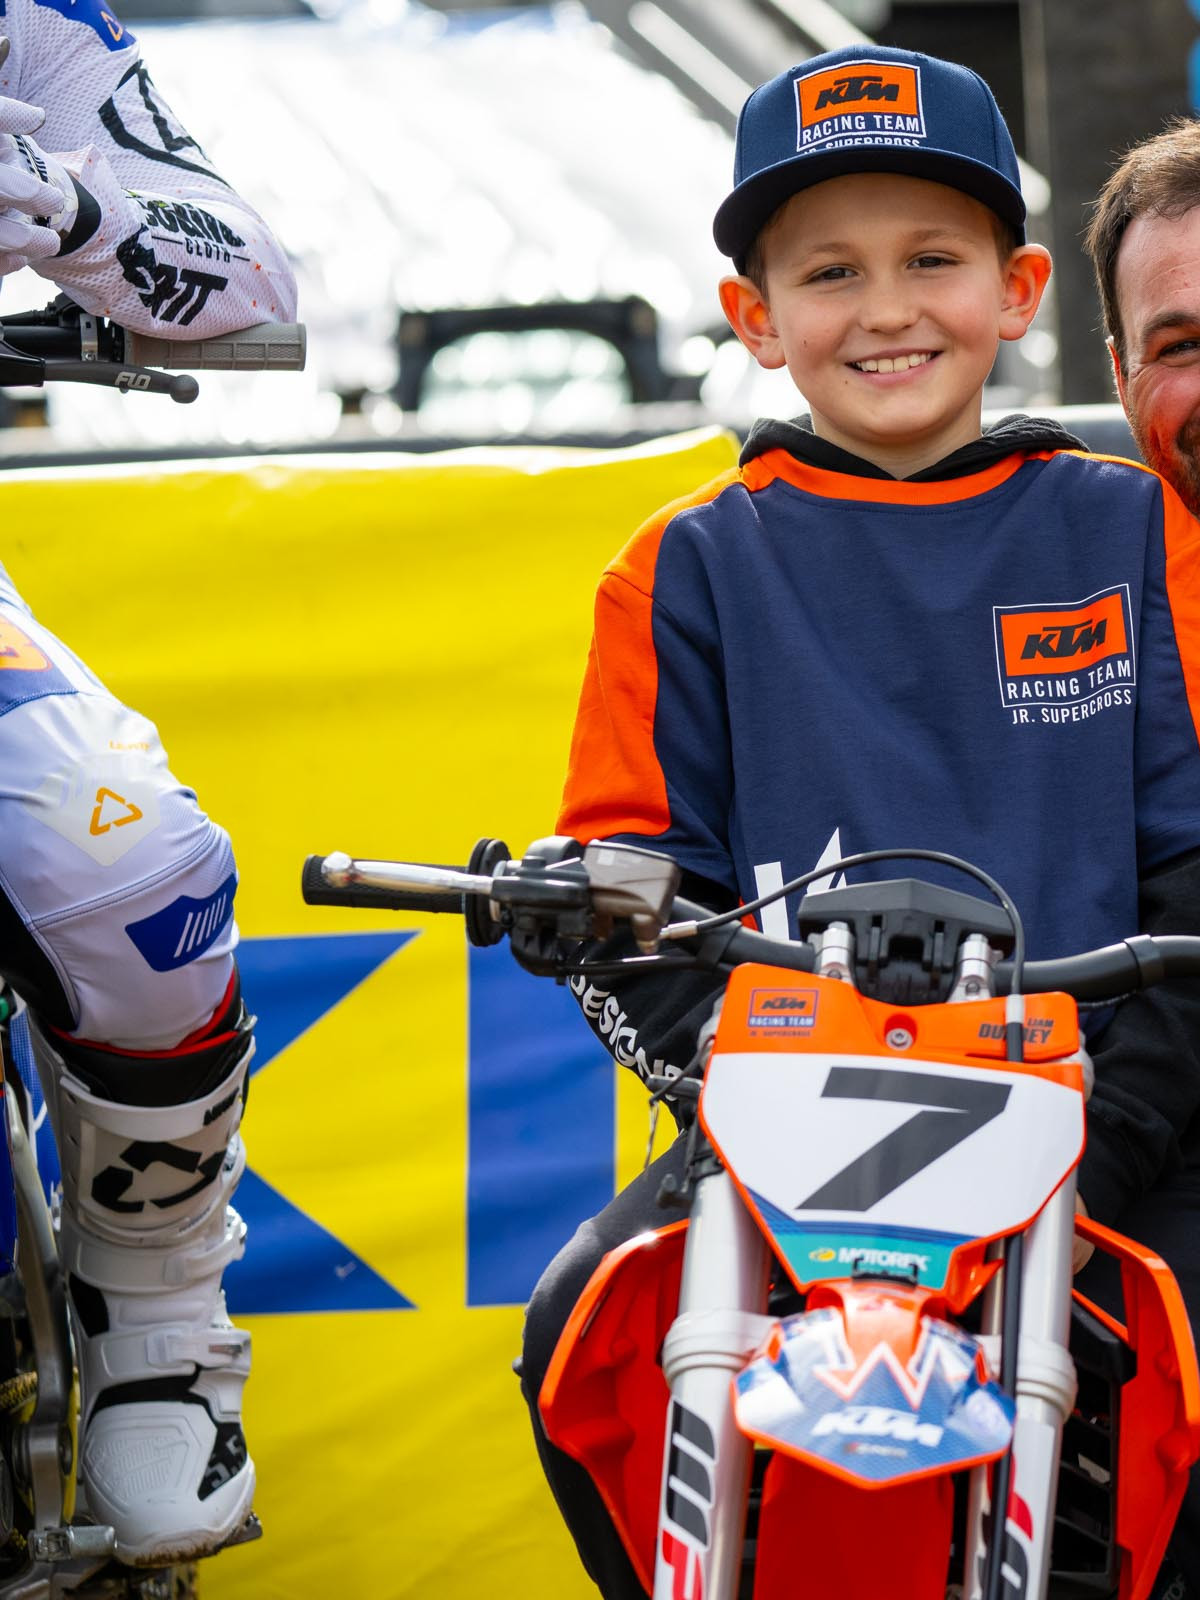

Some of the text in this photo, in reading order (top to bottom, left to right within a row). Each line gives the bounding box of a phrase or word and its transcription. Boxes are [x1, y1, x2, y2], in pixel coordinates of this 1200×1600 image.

[814, 76, 899, 111] KTM
[802, 114, 920, 145] RACING TEAM
[115, 371, 152, 390] FLO
[1020, 617, 1108, 660] KTM
[1006, 659, 1132, 700] RACING TEAM
[1012, 688, 1132, 725] JR. SUPERCROSS
[761, 996, 807, 1010] KTM
[794, 1066, 1014, 1213] 7
[838, 1247, 930, 1272] MOTOREX
[810, 1405, 945, 1448] KTM
